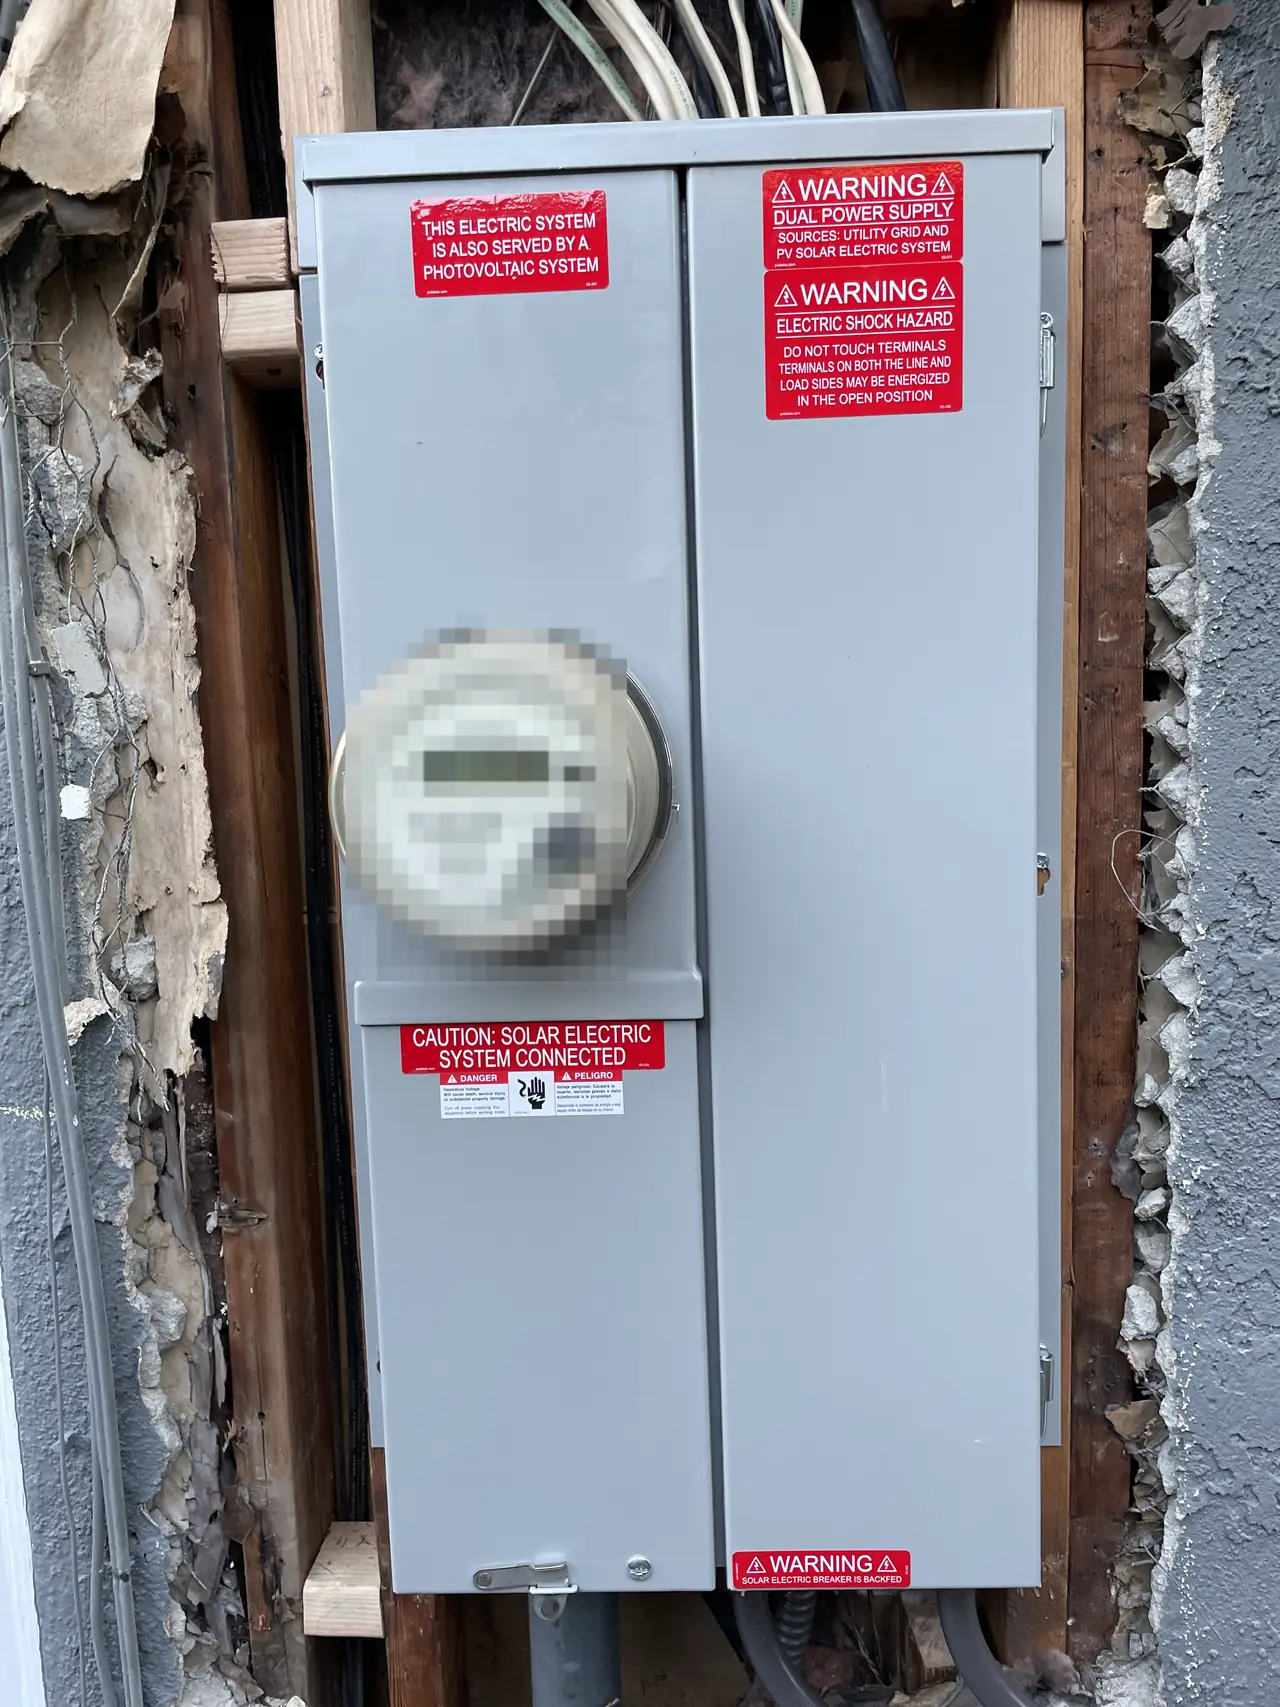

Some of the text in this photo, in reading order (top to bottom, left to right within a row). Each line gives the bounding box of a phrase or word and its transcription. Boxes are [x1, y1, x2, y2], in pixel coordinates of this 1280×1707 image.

[798, 174, 927, 202] WARNING
[421, 212, 596, 236] THIS ELECTRIC SYSTEM
[773, 202, 954, 226] DUAL POWER SUPPLY
[778, 225, 949, 244] SOURCES: UTILITY GRID AND
[432, 235, 589, 258] IS ALSO SERVED BY A
[776, 241, 951, 260] PV SOLAR ELECTRIC SYSTEM
[423, 257, 599, 280] PHOTOVOLTAIC SYSTEM
[800, 278, 928, 306] WARNING
[776, 311, 953, 334] ELECTRIC SHOCK HAZARD
[783, 339, 946, 358] DO NOT TOUCH TERMINALS
[778, 355, 952, 375] TERMINALS ON BOTH THE LINE AND
[780, 372, 950, 391] LOAD SIDES MAY BE ENERGIZED
[797, 389, 933, 407] IN THE OPEN POSITION
[412, 1024, 652, 1047] CAUTION: SOLAR ELECTRIC
[439, 1047, 627, 1069] SYSTEM CONNECTED
[460, 1074, 498, 1082] DANGER
[574, 1071, 613, 1080] PELIGRO
[769, 1554, 873, 1573] WARNING
[741, 1575, 902, 1585] SOLAR ELECTRIC BREAKER IS BACKFED
